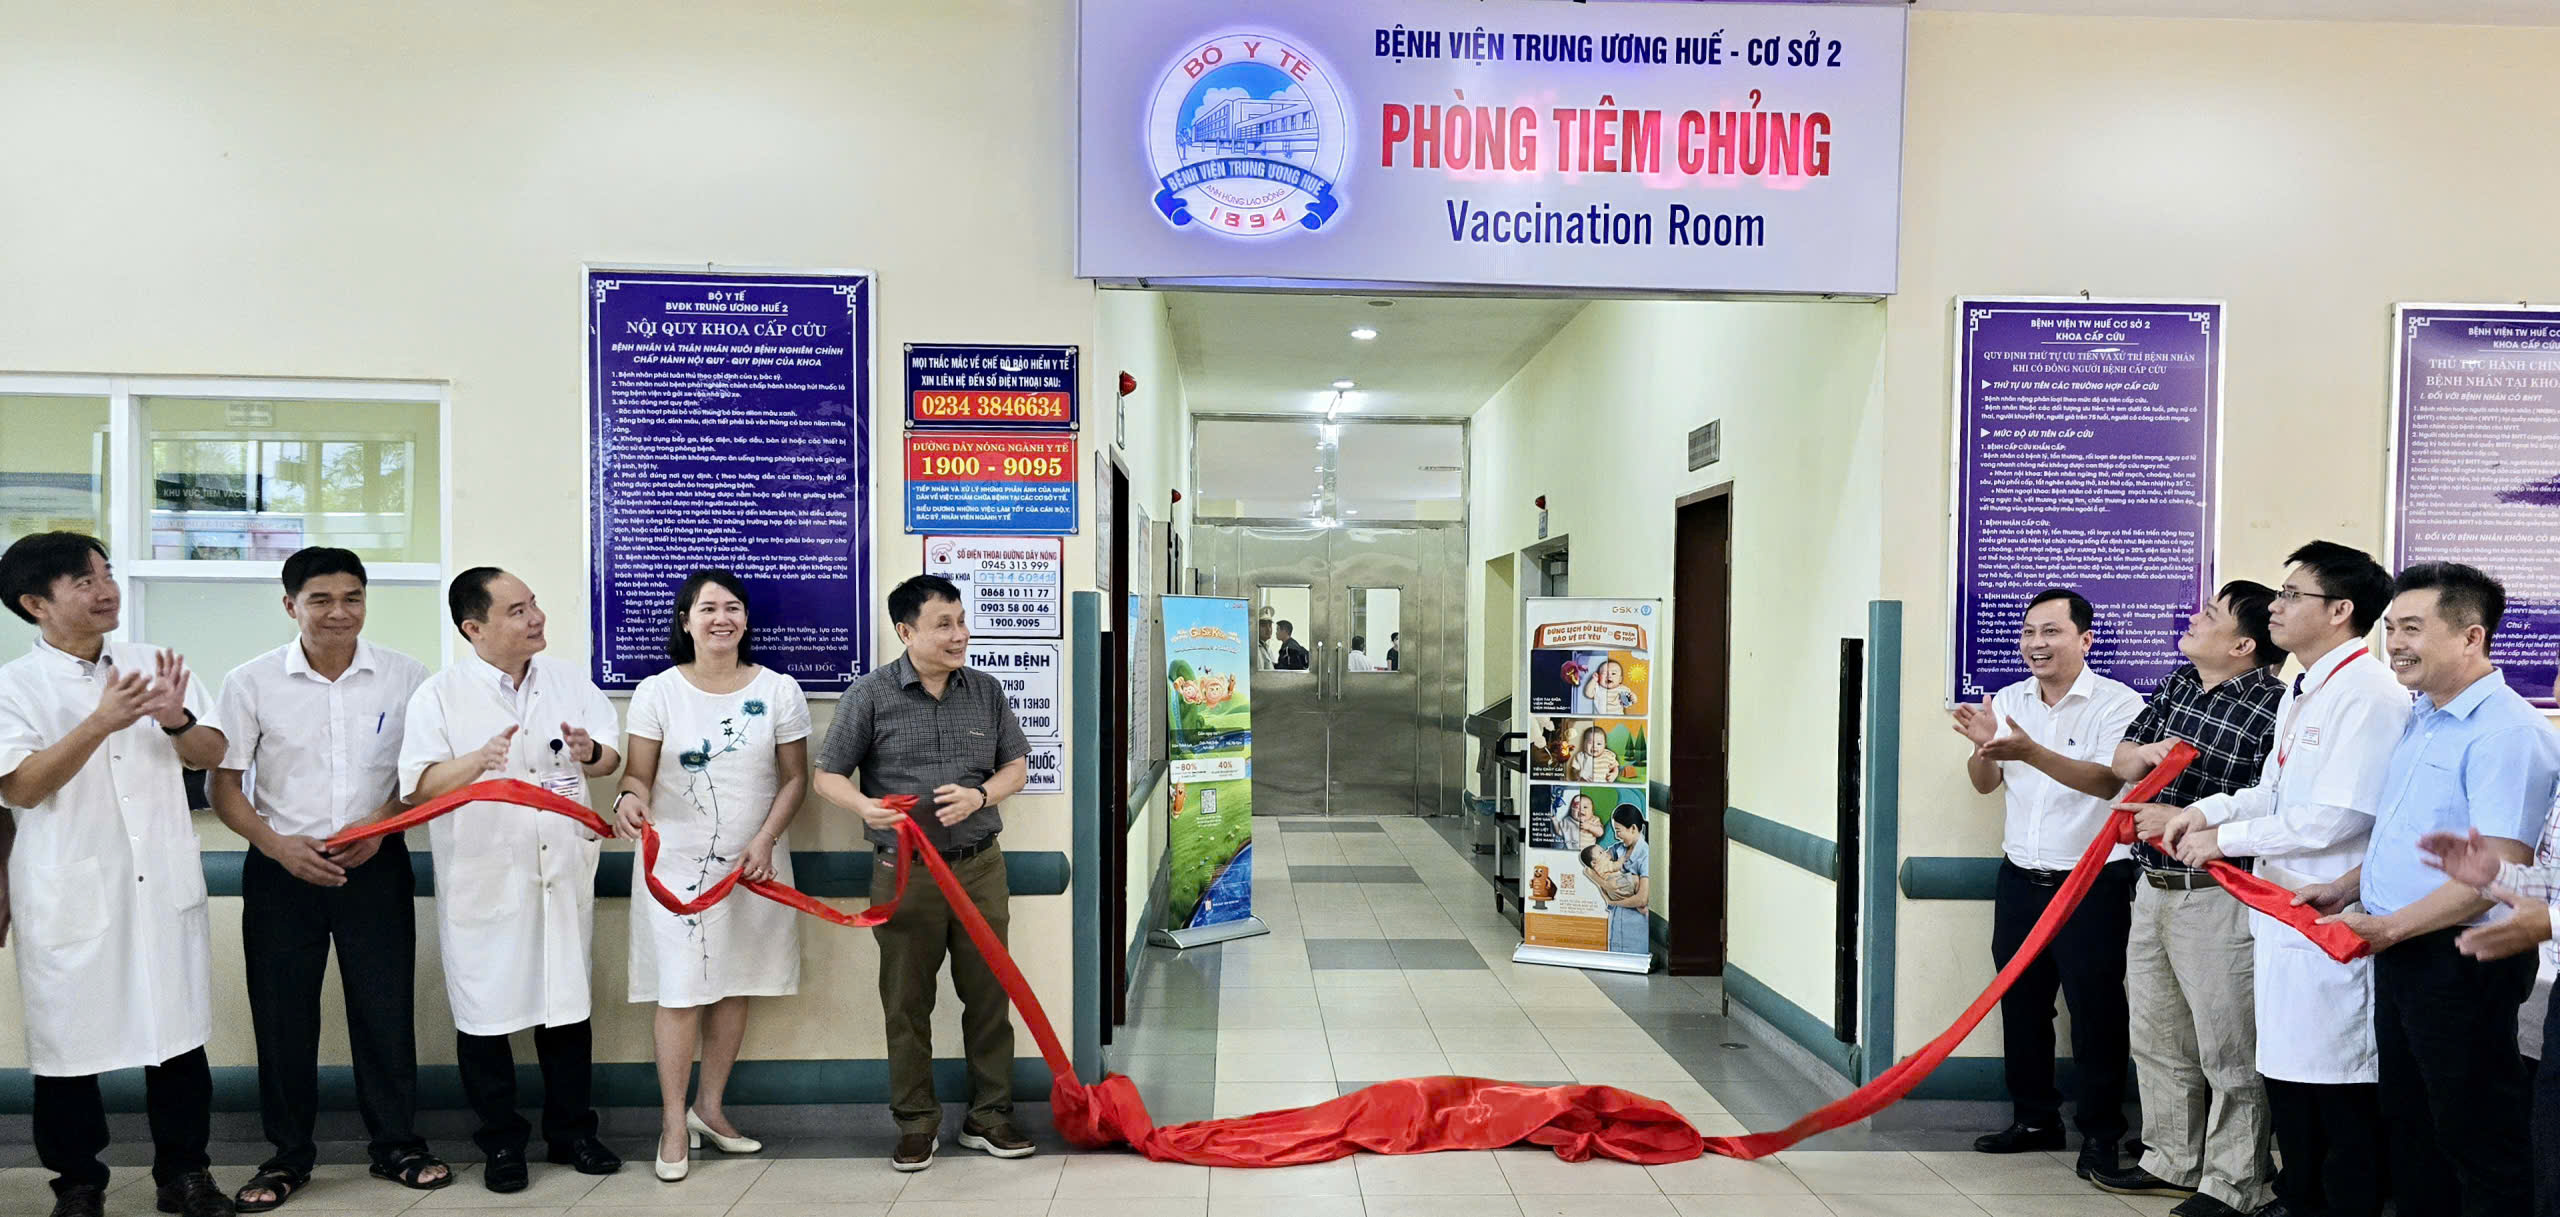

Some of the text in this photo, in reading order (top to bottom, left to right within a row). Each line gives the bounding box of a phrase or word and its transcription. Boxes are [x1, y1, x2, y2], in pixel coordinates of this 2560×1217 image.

[1243, 41, 1262, 59] Y
[1376, 25, 1841, 66] BỆNH VIỆN TRUNG ƯƠNG HUẾ CƠ SỞ 2
[1382, 88, 1832, 176] PHÒNG TIÊM CHỦNG
[1166, 168, 1199, 193] BỆNH
[1199, 160, 1227, 180] VIỆN
[1228, 160, 1265, 178] TRUNG
[1209, 206, 1287, 228] 1894
[1447, 200, 1763, 246] Vaccination Room
[708, 290, 723, 302] BỘ
[725, 292, 732, 300] Y
[666, 301, 788, 312] BVĐK TRUNG ƯƠNG HUẾ 2
[626, 318, 828, 338] NỘI QUY KHOA CẤP CỨU
[2031, 318, 2054, 329] BỆNH
[2056, 319, 2076, 329] VIỆN
[2094, 319, 2111, 328] HUẾ
[2113, 320, 2127, 328] CƠ
[2130, 319, 2142, 328] SỞ
[2056, 331, 2124, 340] KHOA CẤP CỨU
[2468, 326, 2491, 338] BỆNH
[2493, 326, 2513, 338] VIỆN
[2530, 327, 2548, 336] HUẾ
[2493, 341, 2518, 349] KHOA
[912, 357, 926, 369] MỌI
[982, 355, 998, 368] CHẾ
[1052, 359, 1056, 369] Y
[2426, 374, 2462, 388] BỆNH
[922, 395, 1060, 416] 0234 3846634
[913, 442, 950, 451] ĐƯỜNG
[952, 441, 973, 451] DÂY
[976, 442, 1005, 451] NÓNG
[1046, 444, 1052, 452] Y
[1054, 443, 1068, 452] TẾ
[923, 456, 1061, 476] 1900 9095
[981, 560, 1048, 569] 0945 313 999
[955, 573, 971, 581] KHOA
[981, 588, 1048, 597] 0868 10 11 77
[981, 603, 1048, 612] 0903 58 00 46
[1612, 606, 1632, 614] GSK
[990, 618, 1039, 626] 1900.9095
[970, 652, 1050, 670] THĂM BỆNH
[2133, 677, 2157, 685] GIÁM
[1023, 698, 1050, 709] 13H30
[1022, 717, 1050, 727] 21H00
